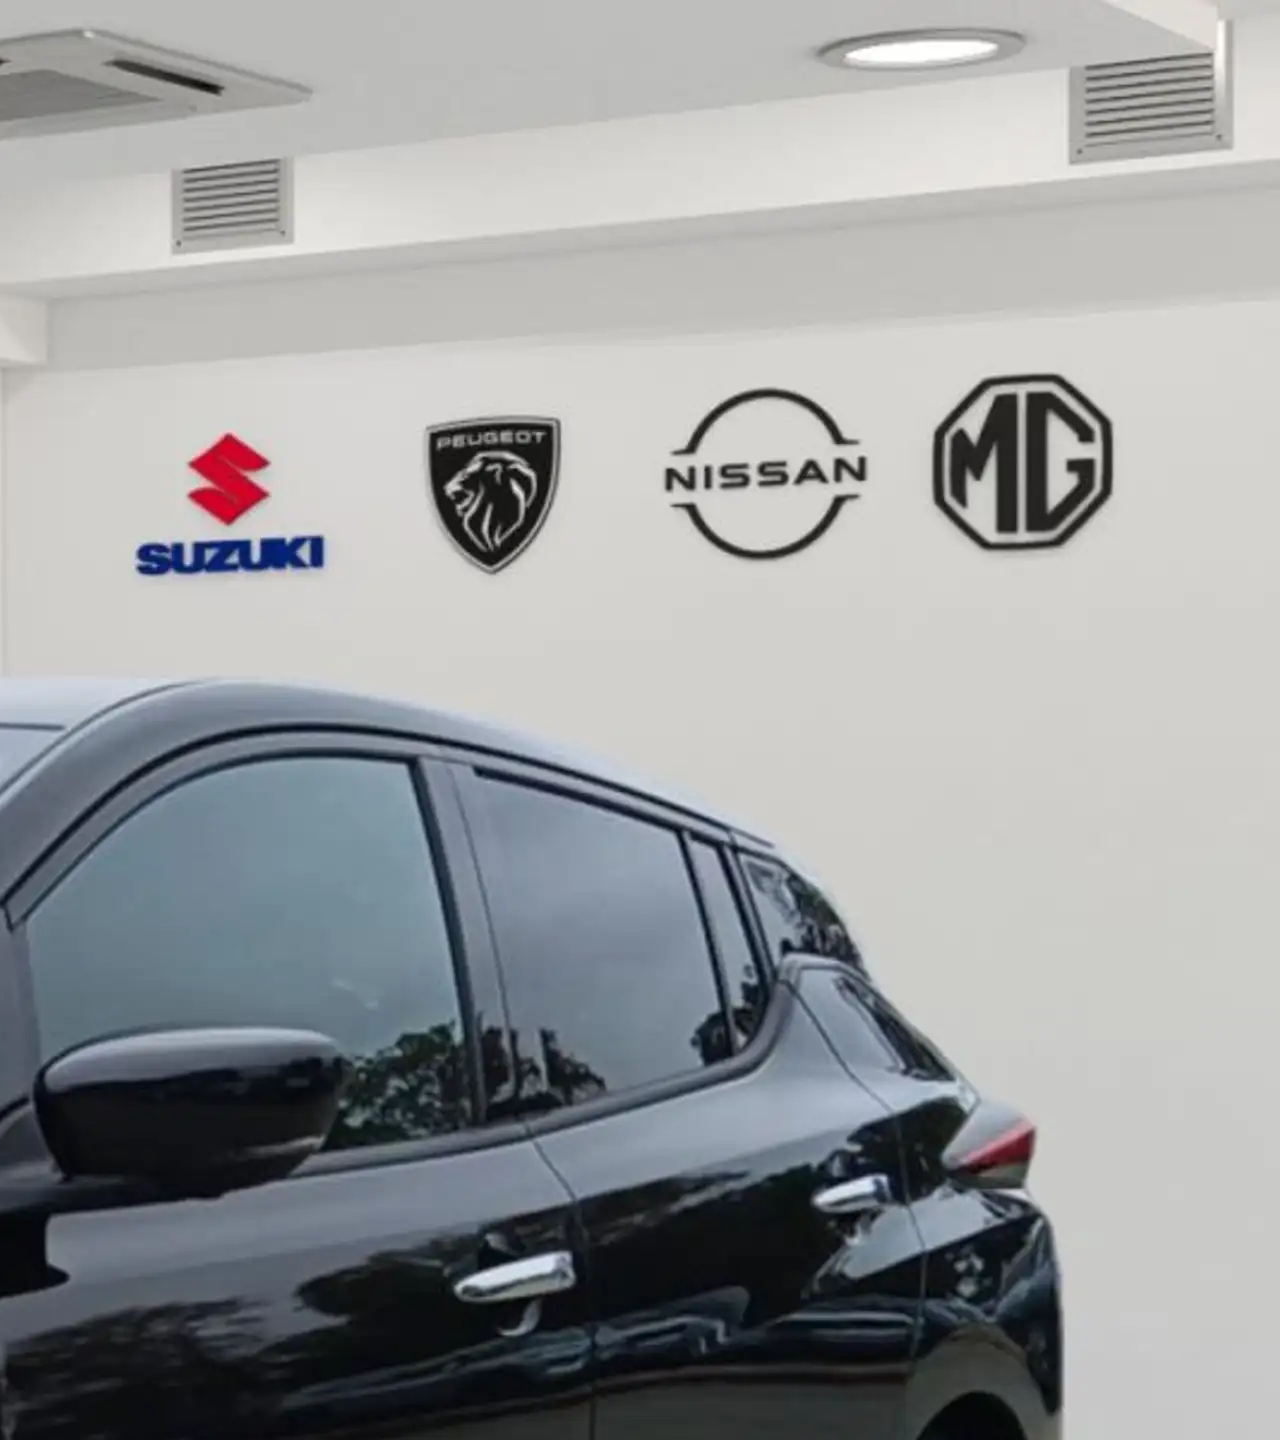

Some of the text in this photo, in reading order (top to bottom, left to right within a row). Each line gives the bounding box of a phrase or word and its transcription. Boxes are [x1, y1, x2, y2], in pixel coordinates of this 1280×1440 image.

[436, 430, 547, 450] PEUGEOT
[664, 453, 868, 493] NISSAN
[949, 389, 1096, 535] MG
[136, 535, 325, 577] SUZUKI
